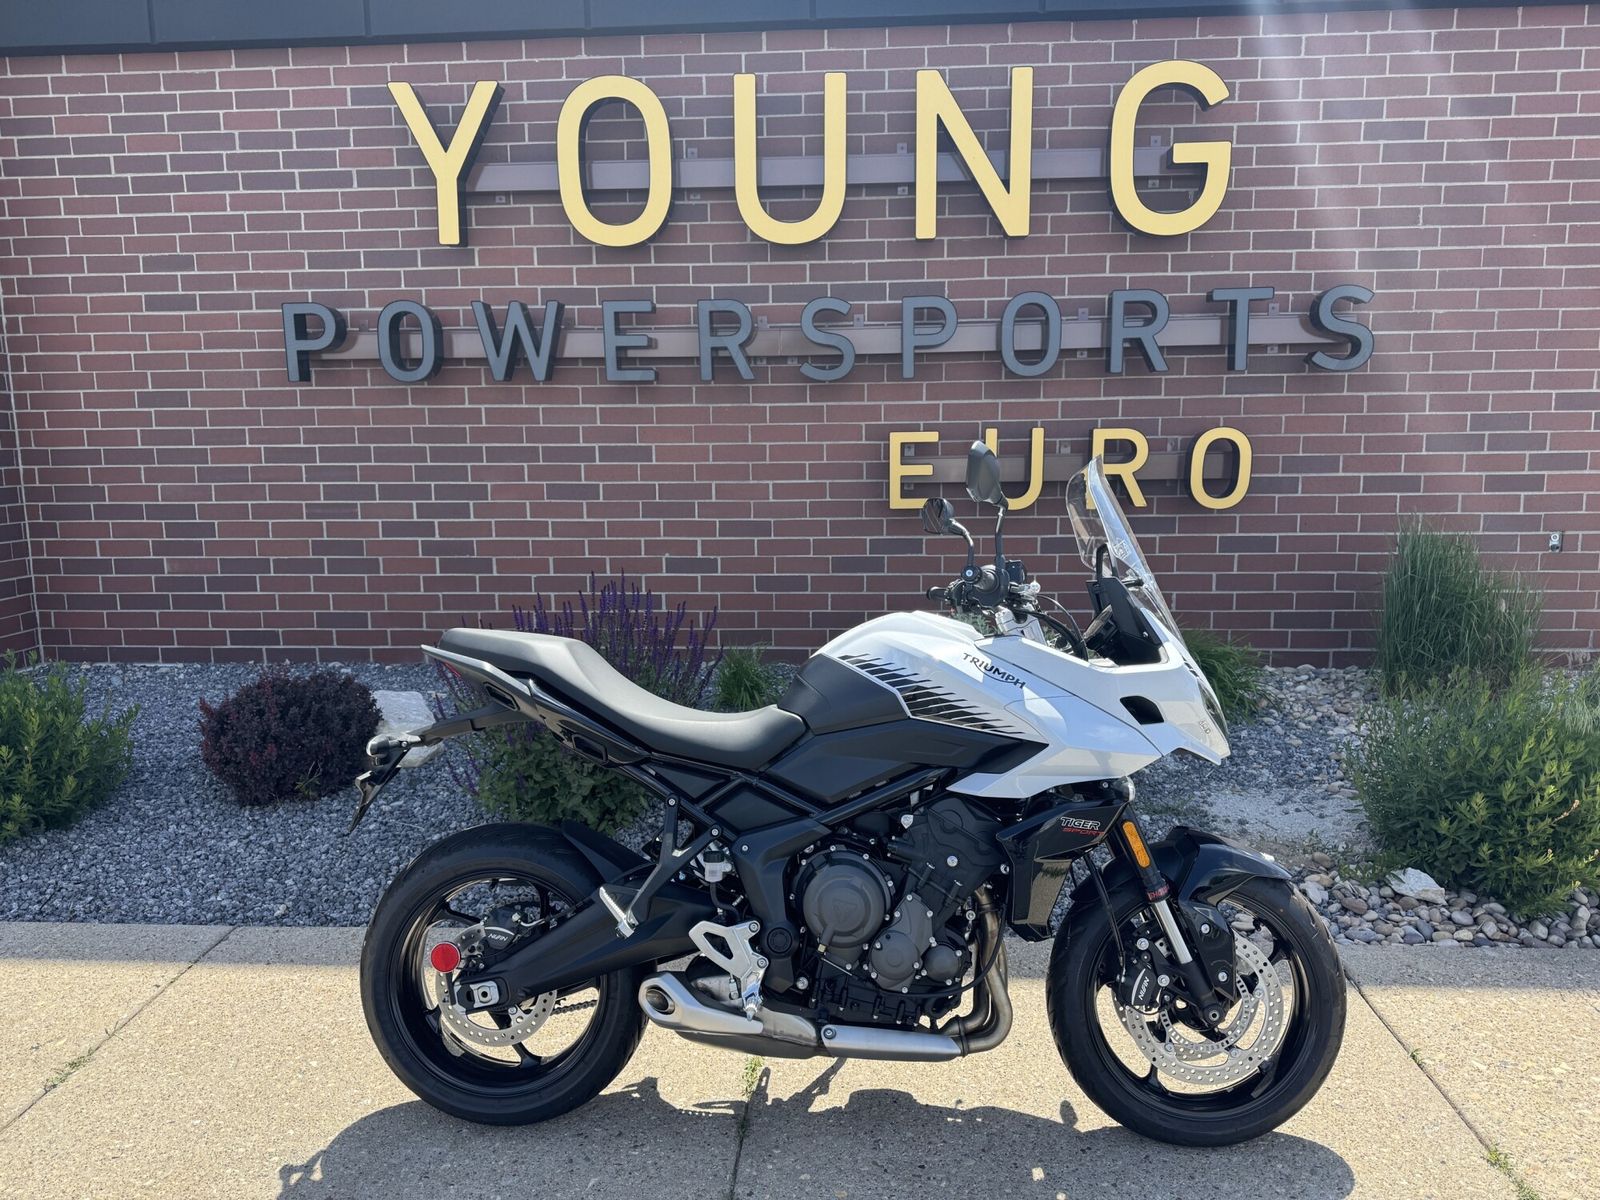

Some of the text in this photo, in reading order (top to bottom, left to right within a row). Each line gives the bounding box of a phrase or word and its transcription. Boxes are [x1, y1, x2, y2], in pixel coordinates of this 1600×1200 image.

[387, 60, 1232, 247] YOUNG
[281, 284, 1375, 383] POWERSPORTS
[889, 427, 1252, 511] EURO
[963, 652, 1026, 689] TRIUMPH
[1060, 816, 1101, 831] TIGER
